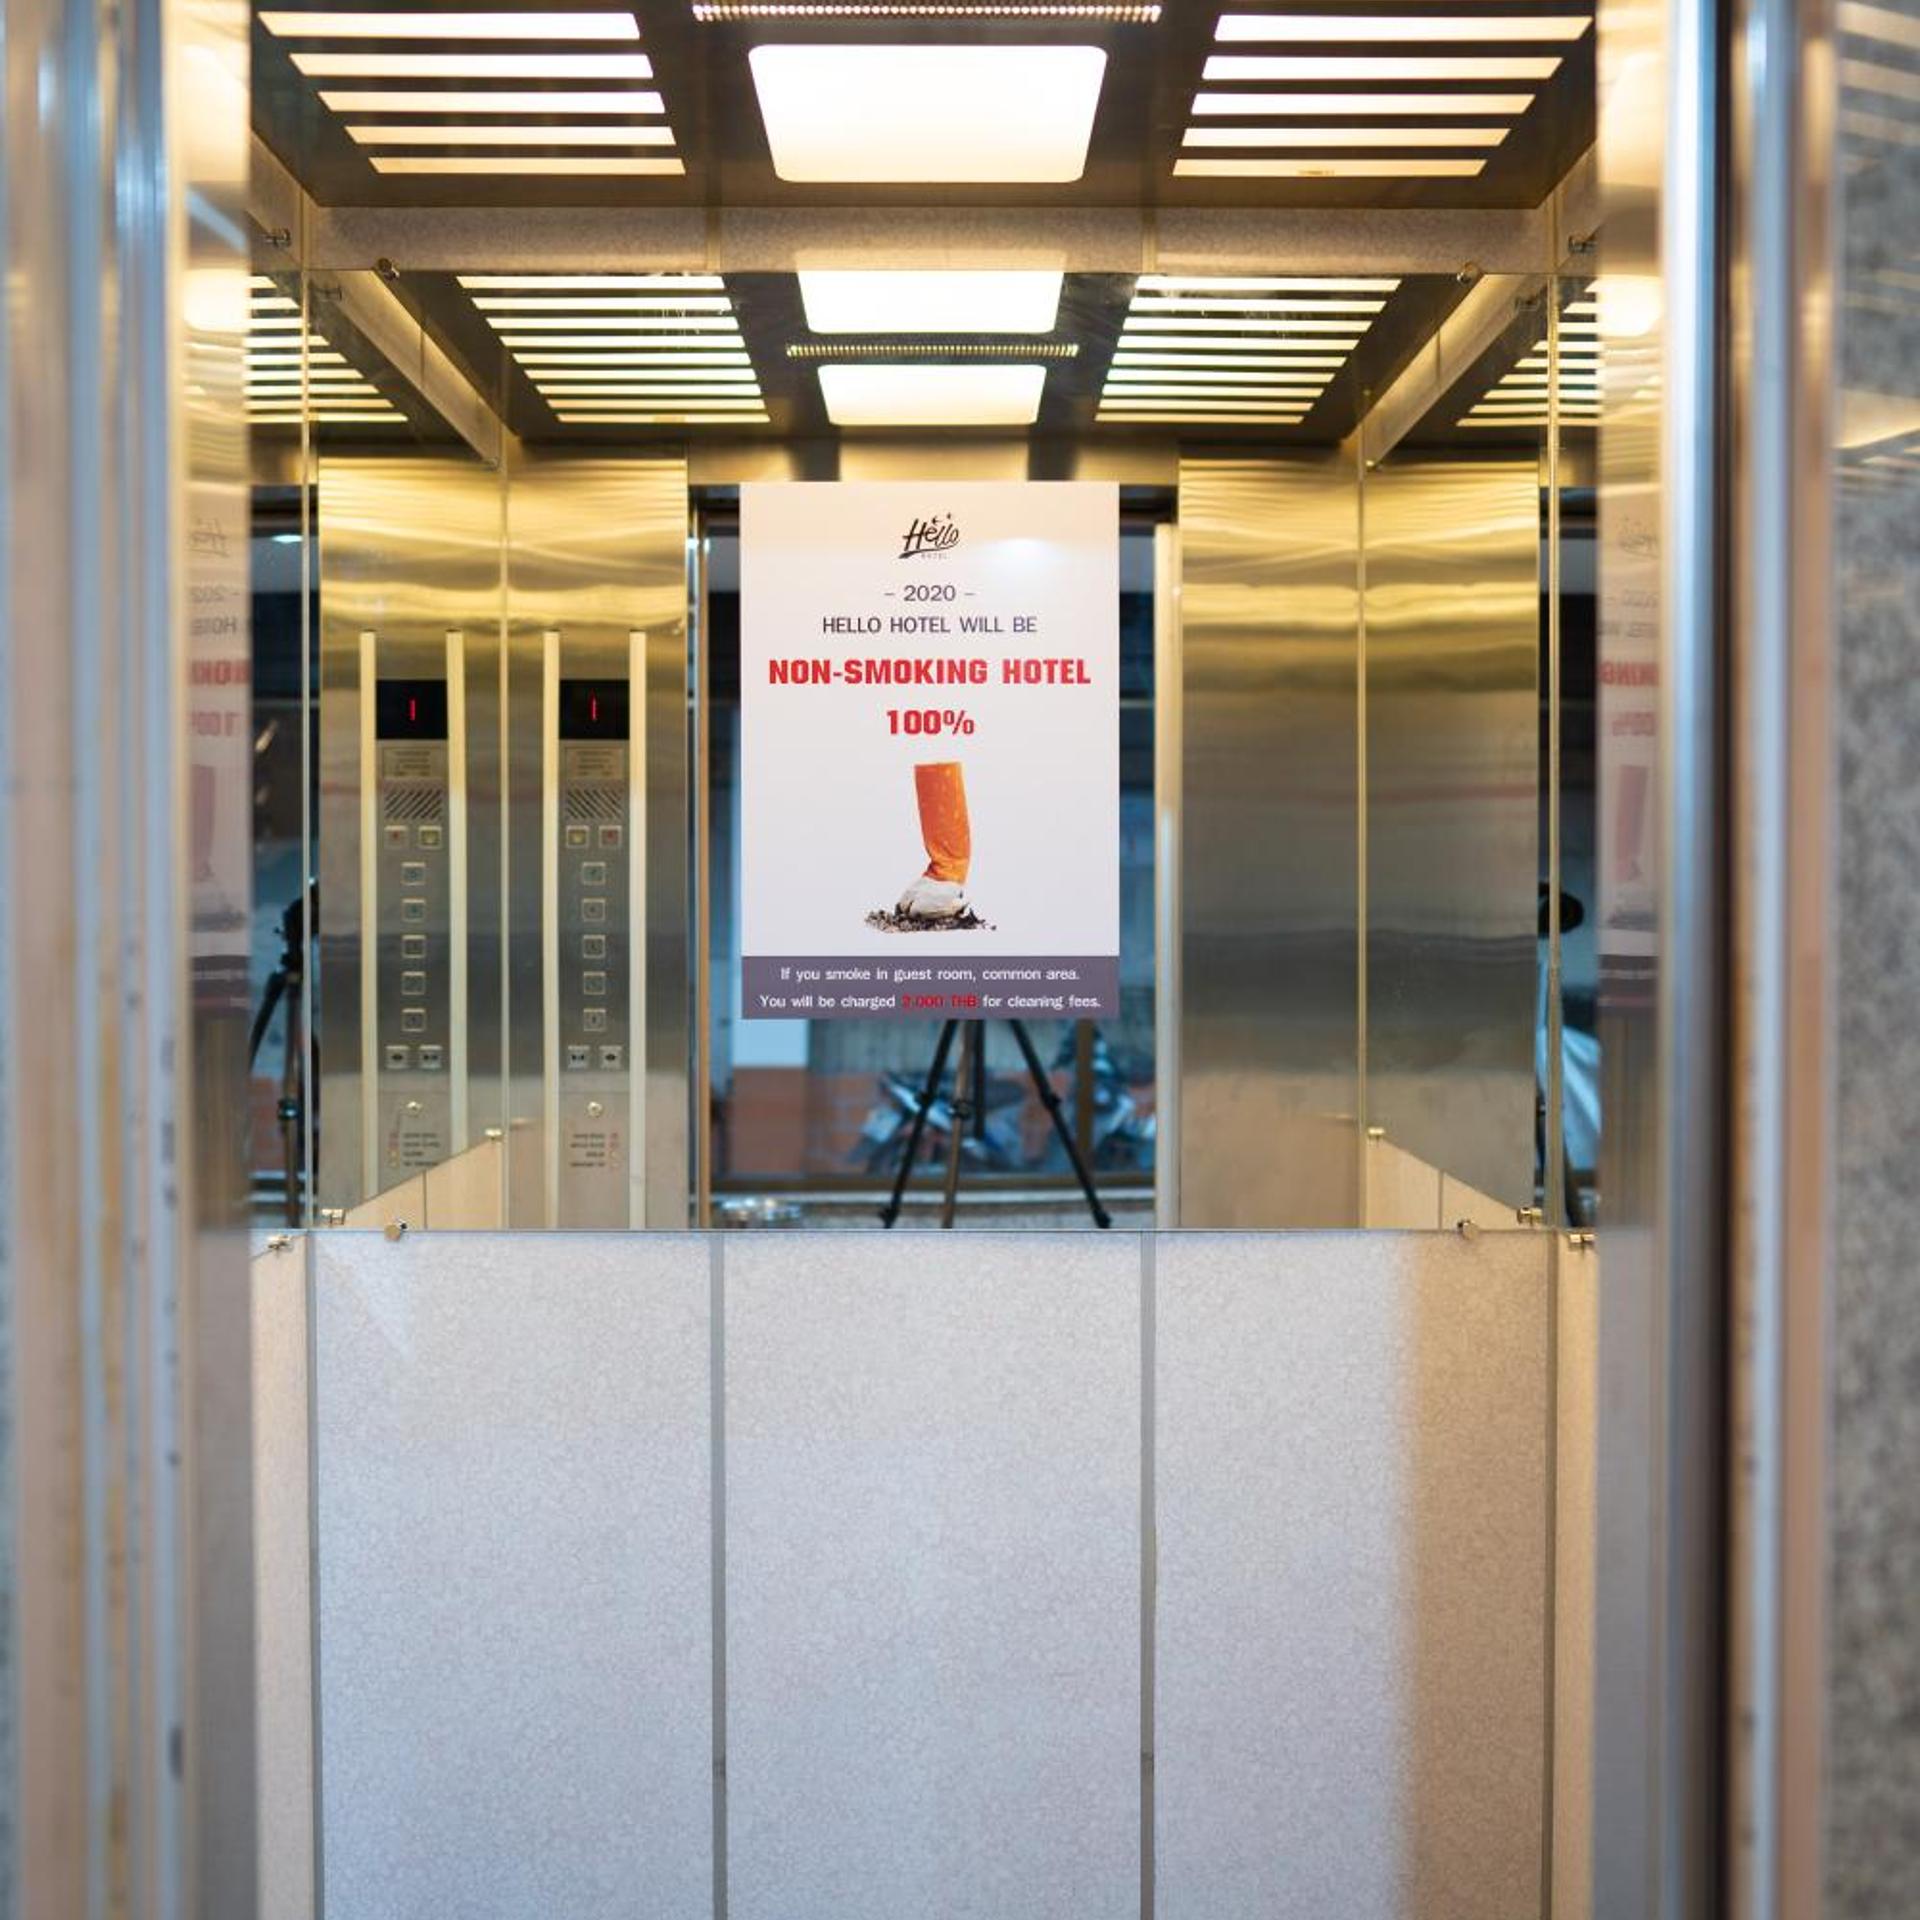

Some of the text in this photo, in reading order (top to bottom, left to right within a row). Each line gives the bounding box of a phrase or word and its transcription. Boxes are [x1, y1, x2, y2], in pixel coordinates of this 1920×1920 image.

[899, 515, 961, 558] Hello
[903, 584, 956, 602] 2020
[822, 616, 1038, 634] HELLO HOTEL WILL BE
[768, 658, 1092, 685] NON-SMOKING HOTEL
[886, 709, 975, 736] 100%
[780, 967, 1080, 984] If you smoke in guest room, common area.
[759, 994, 786, 1008] You
[791, 994, 813, 1008] will
[817, 994, 836, 1008] be
[840, 994, 896, 1011] charged
[951, 994, 978, 1008] THB
[982, 994, 1003, 1008] for
[1007, 994, 1065, 1011] cleaning
[1068, 994, 1102, 1008] fees.
